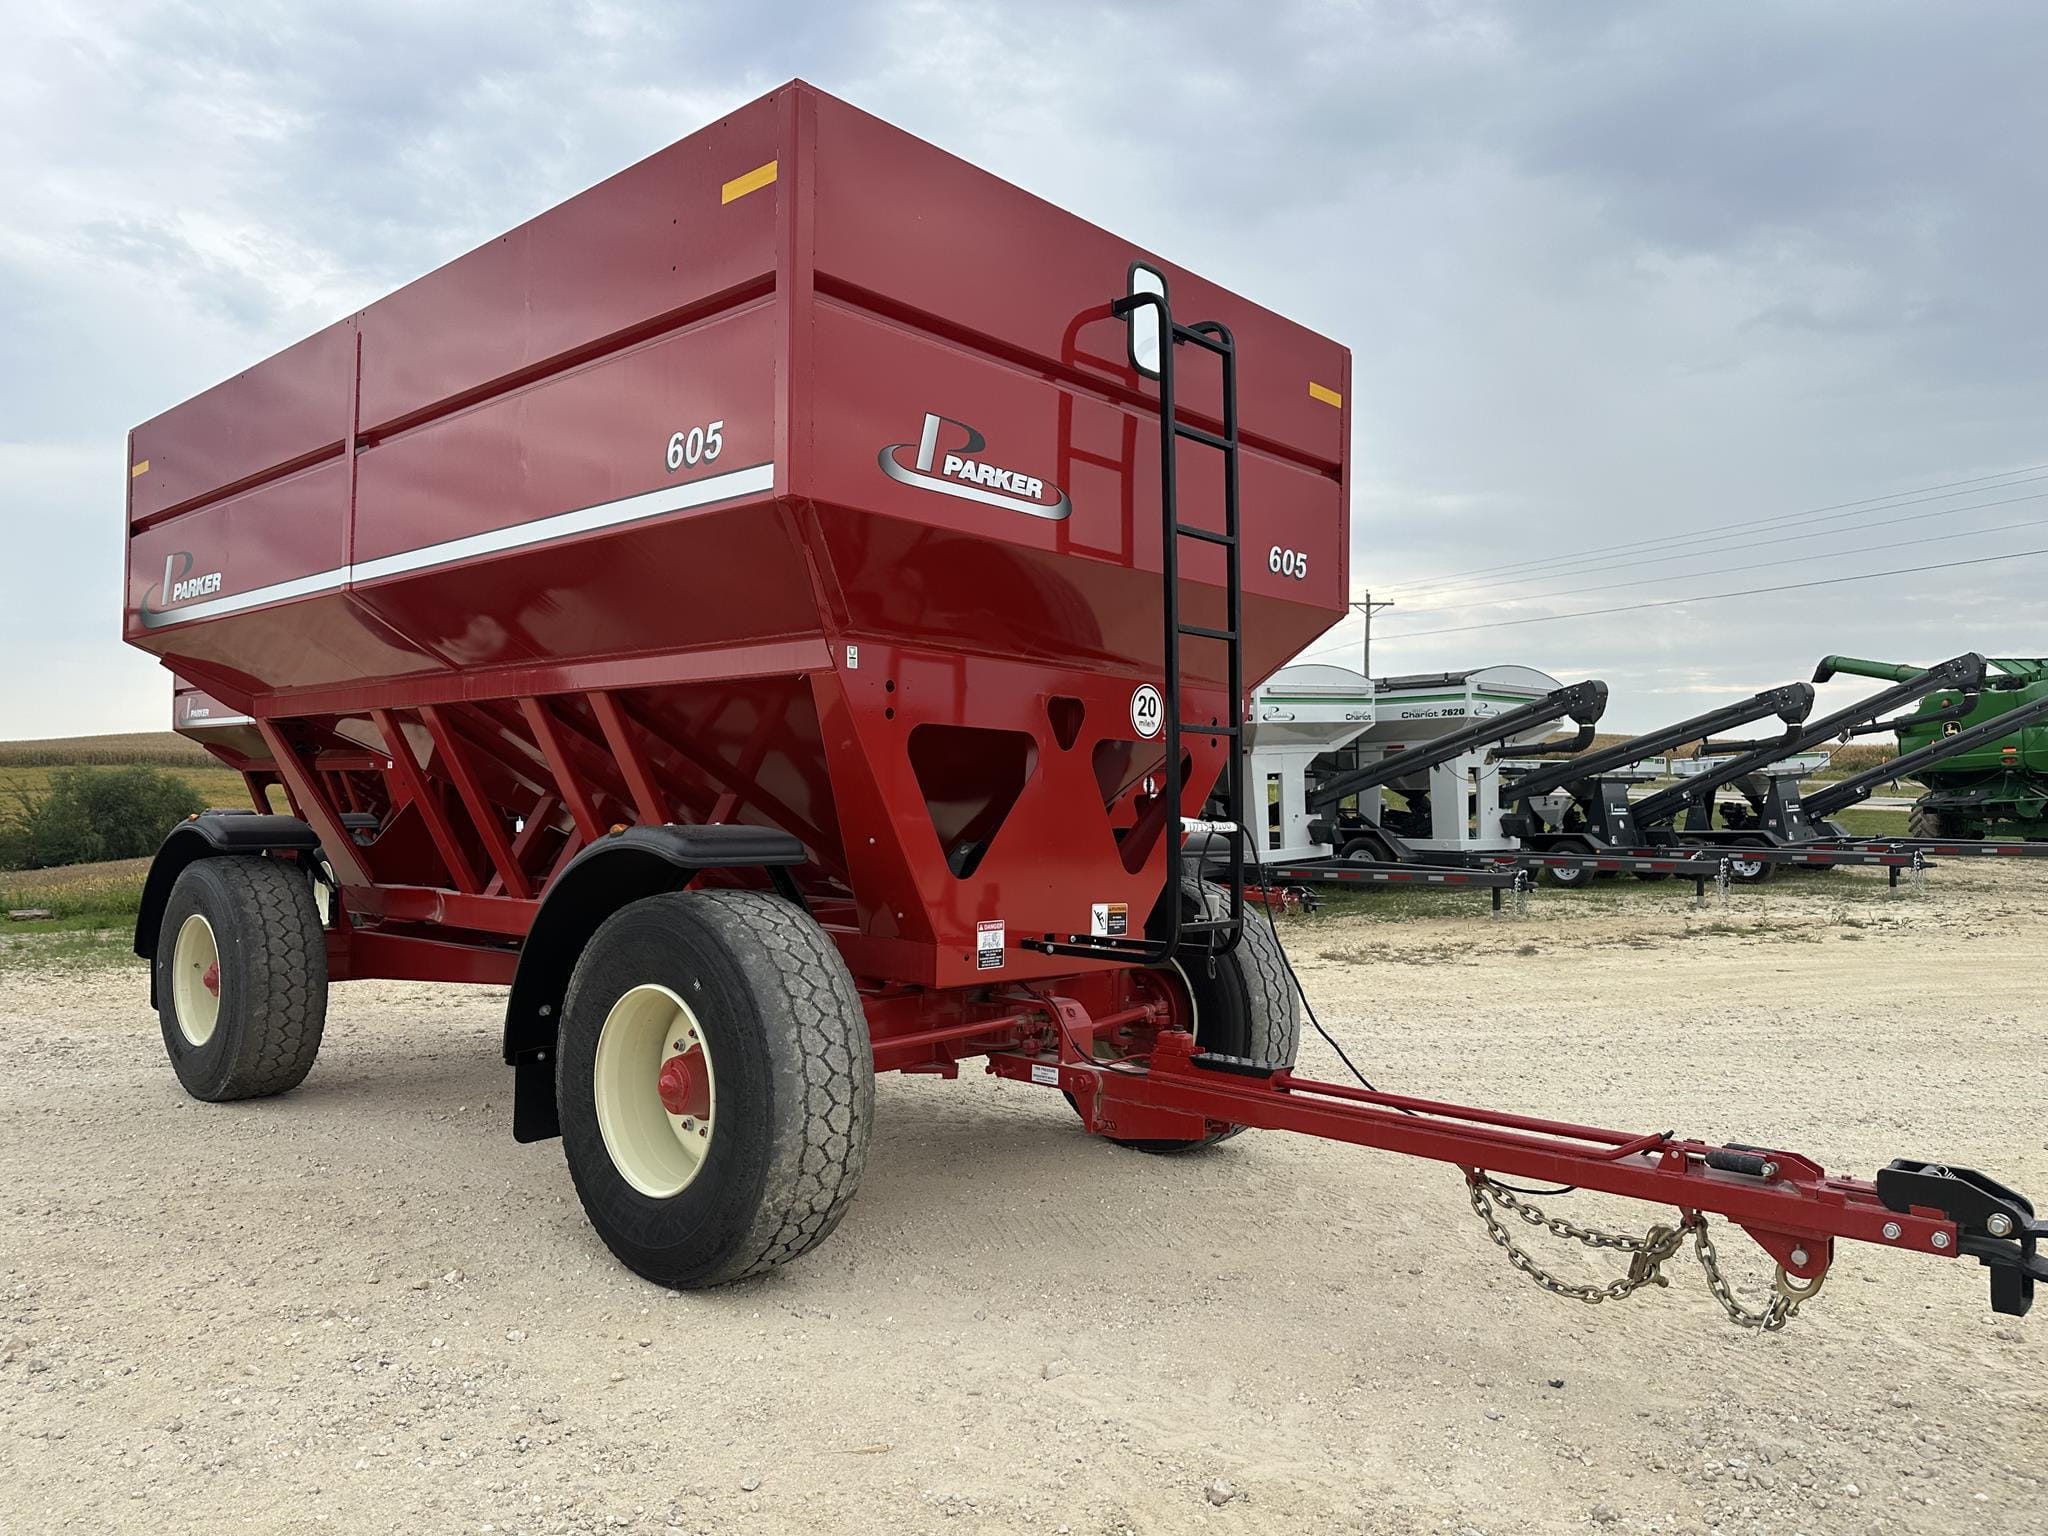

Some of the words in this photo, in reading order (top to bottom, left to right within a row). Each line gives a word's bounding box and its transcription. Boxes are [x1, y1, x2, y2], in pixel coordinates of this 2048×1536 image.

[665, 419, 724, 473] 605
[942, 453, 1044, 500] PARKER
[1268, 545, 1308, 580] 605
[172, 572, 222, 602] PARKER
[1137, 695, 1157, 718] 20
[1345, 712, 1372, 721] Chariot
[1401, 709, 1439, 719] Chariot
[1441, 708, 1465, 716] 2620
[983, 922, 1003, 930] DANGER
